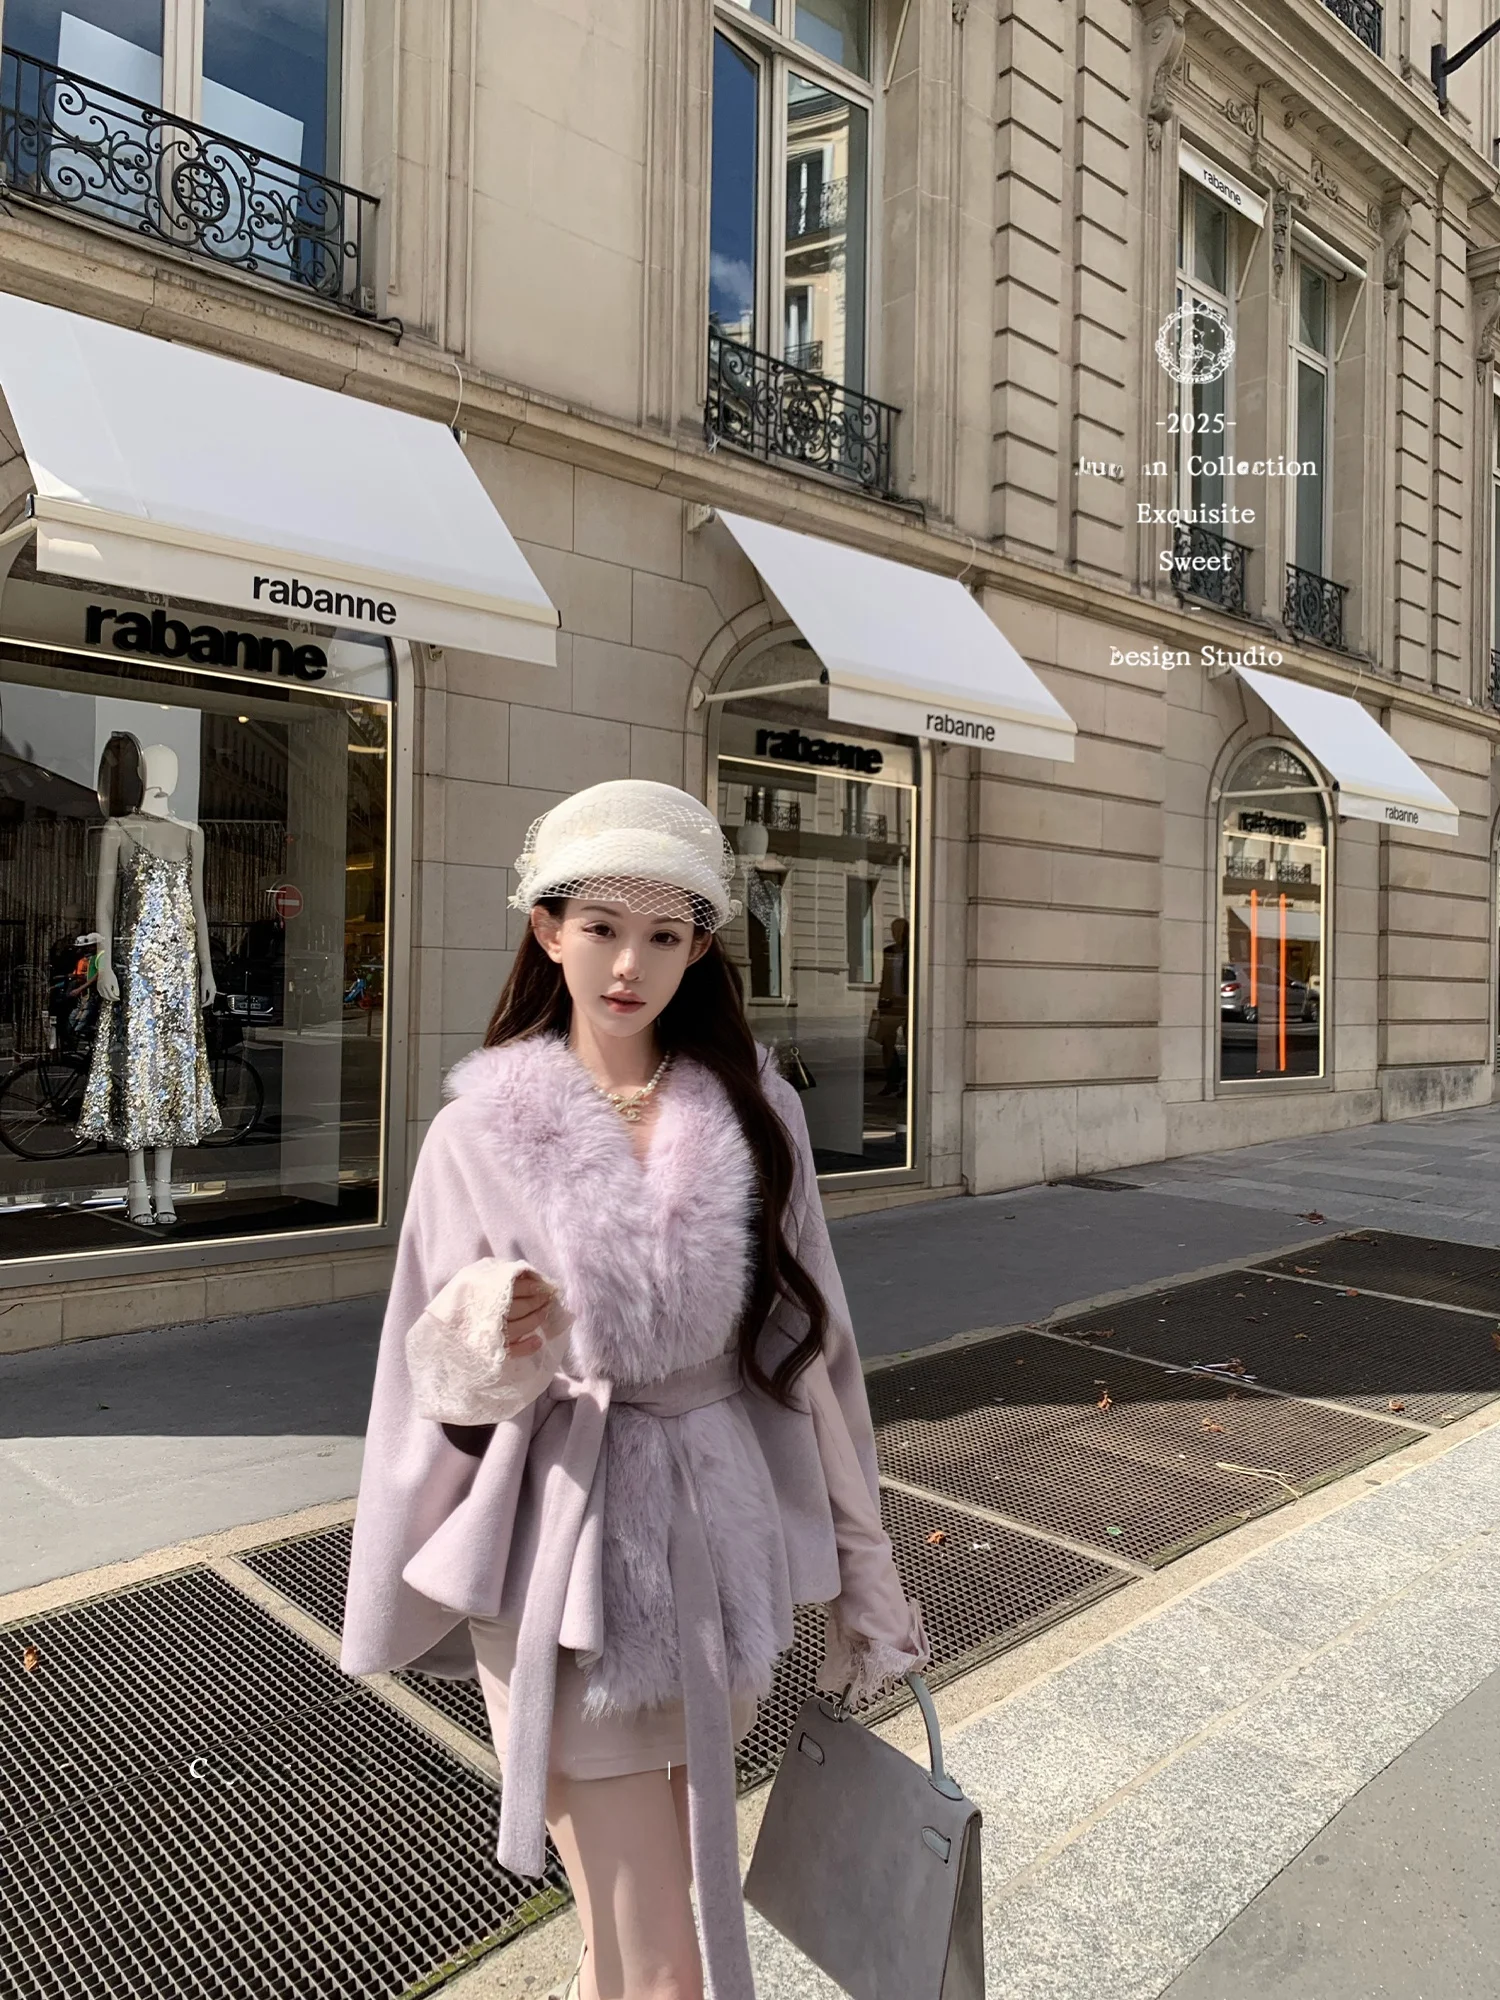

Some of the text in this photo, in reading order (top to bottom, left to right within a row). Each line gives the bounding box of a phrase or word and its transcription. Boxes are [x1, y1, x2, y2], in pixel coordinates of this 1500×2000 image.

[1203, 169, 1242, 206] rabanne
[252, 575, 397, 625] rabanne
[84, 604, 328, 681] rabanne
[926, 713, 995, 742] rabanne
[1384, 805, 1419, 825] rabanne
